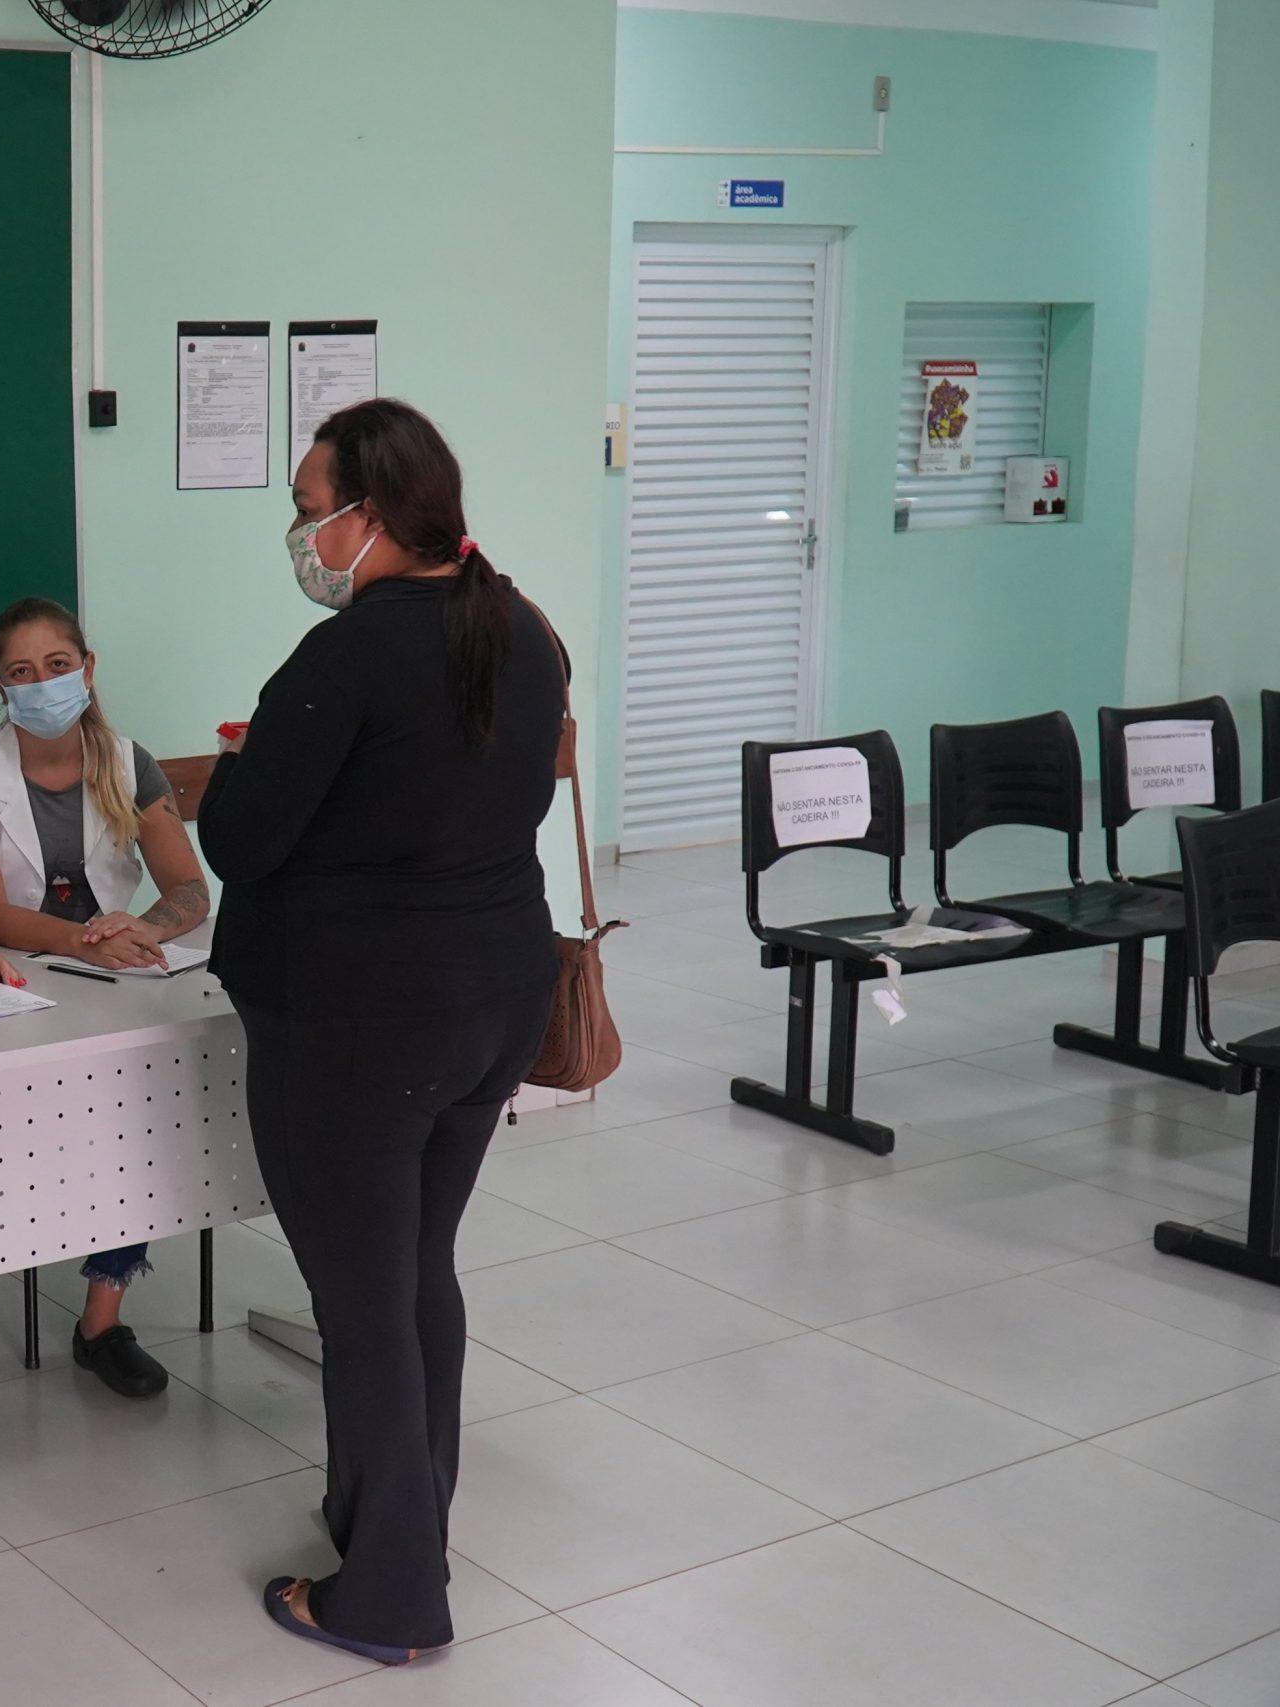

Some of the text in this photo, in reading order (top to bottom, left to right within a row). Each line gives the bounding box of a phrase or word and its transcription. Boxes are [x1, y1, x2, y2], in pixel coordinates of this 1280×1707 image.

[735, 184, 753, 194] área
[735, 194, 779, 204] acadêmica
[1143, 765, 1173, 775] SENTAR
[1174, 763, 1207, 774] NESTA
[1143, 777, 1175, 789] CADEIRA
[777, 795, 864, 813] NÃO SENTAR NESTA
[792, 812, 829, 824] CADEIRA
